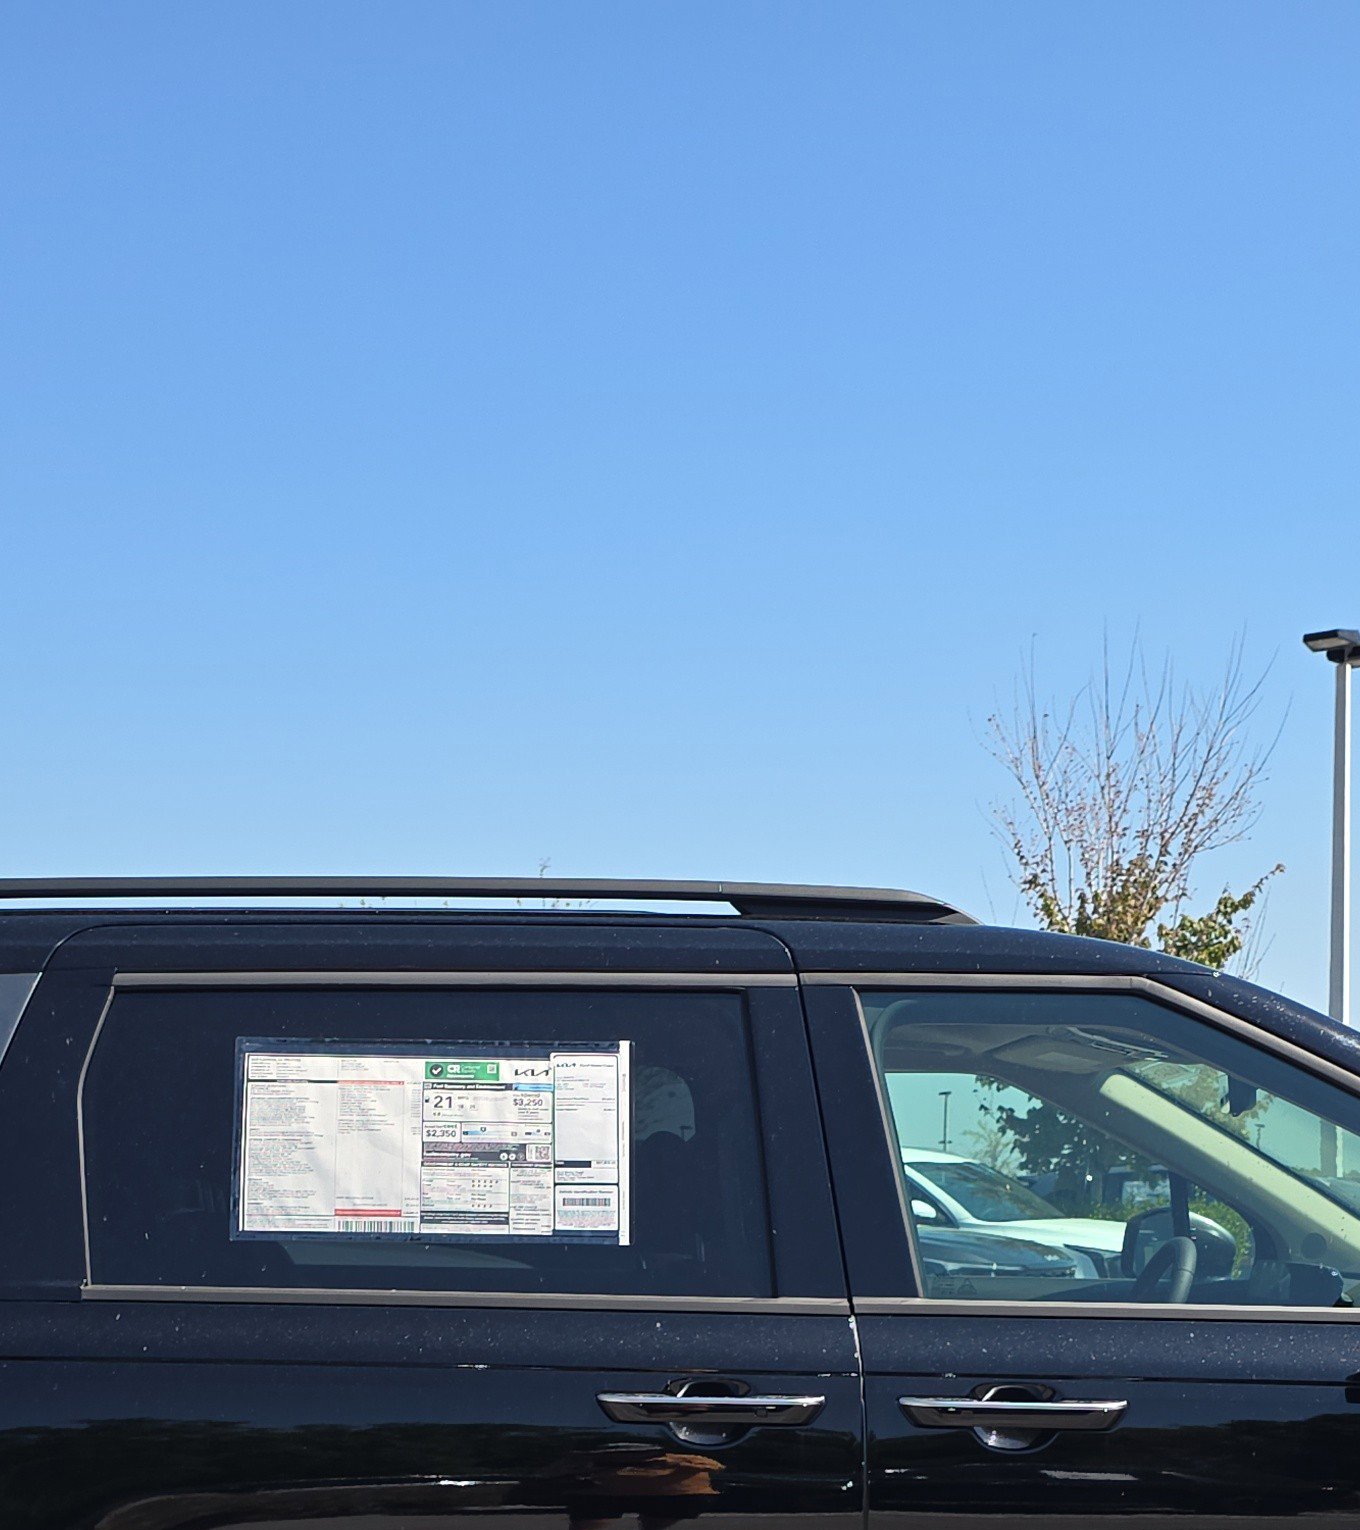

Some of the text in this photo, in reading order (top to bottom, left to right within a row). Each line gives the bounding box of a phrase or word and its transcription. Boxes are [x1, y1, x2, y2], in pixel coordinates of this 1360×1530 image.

[514, 1068, 550, 1077] KIA
[433, 1094, 453, 1109] 21
[512, 1098, 543, 1107] $3,250
[425, 1129, 457, 1138] $2,350
